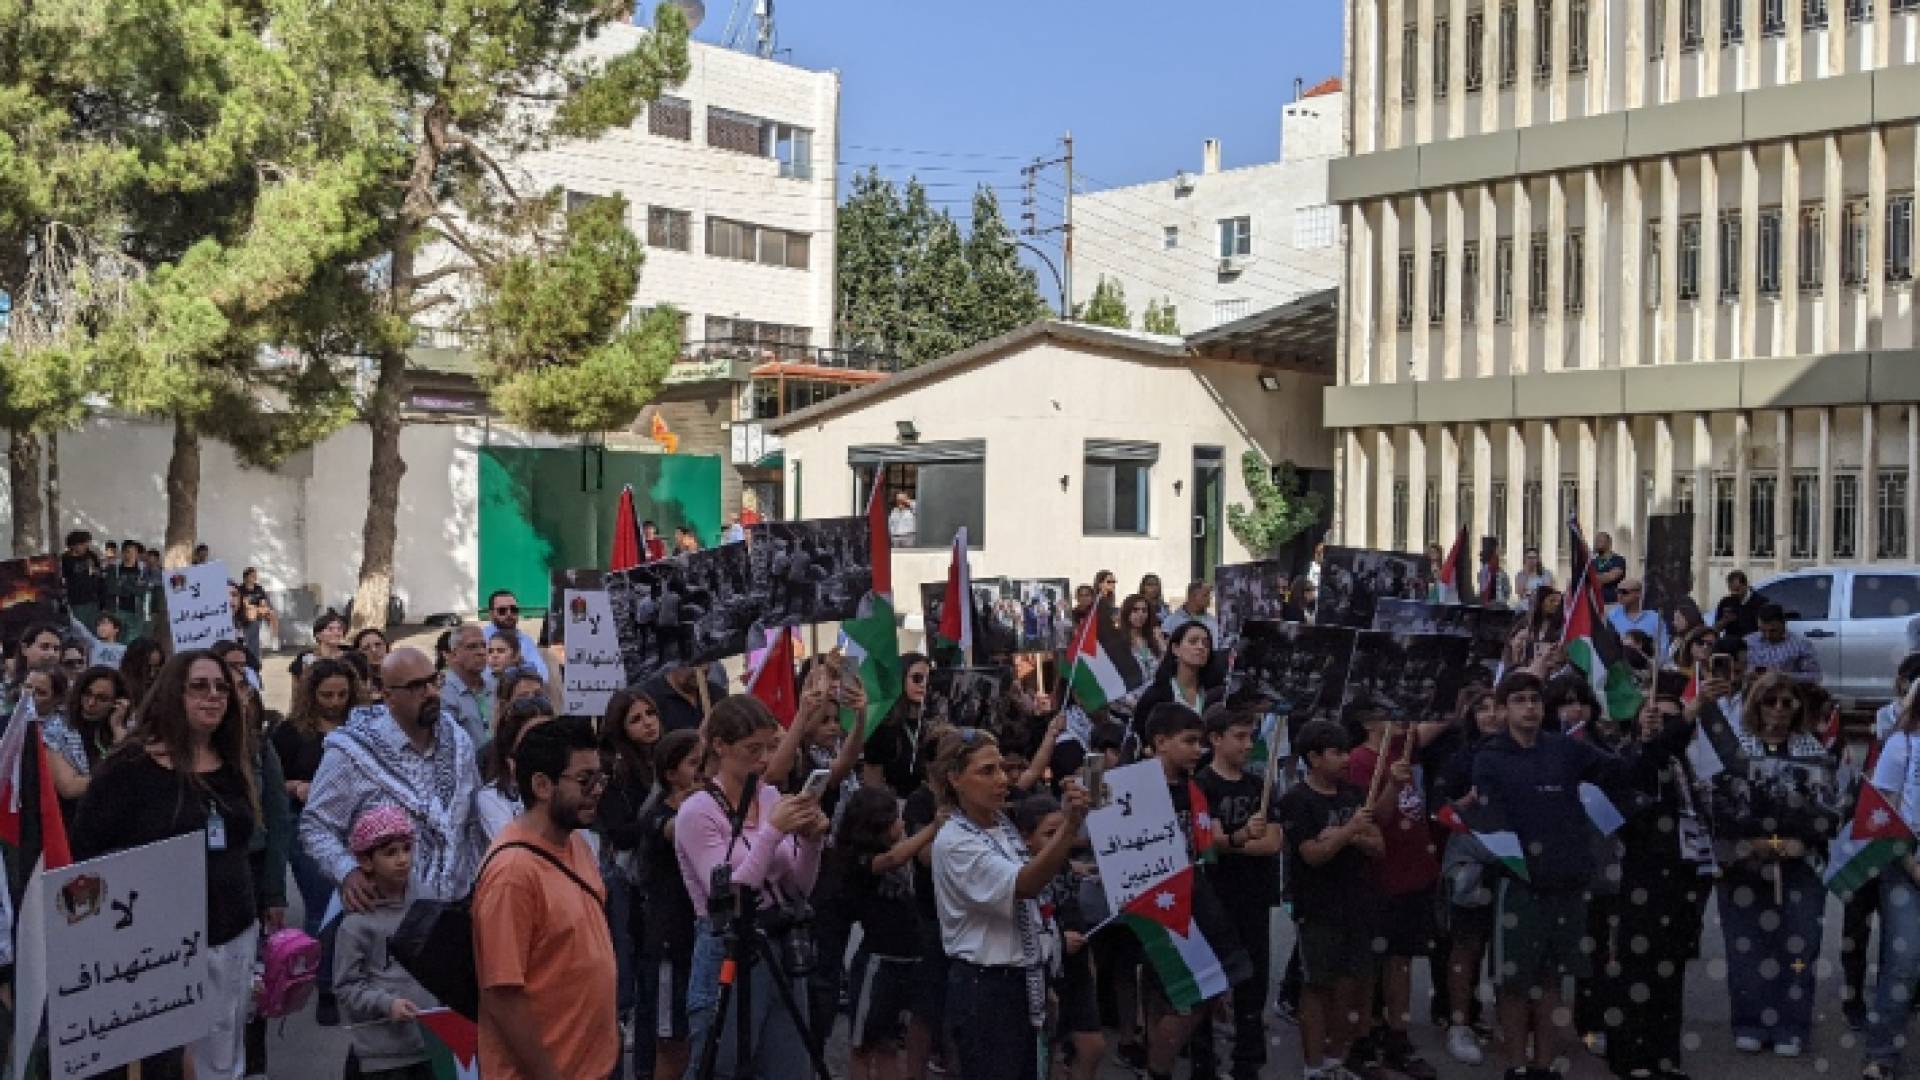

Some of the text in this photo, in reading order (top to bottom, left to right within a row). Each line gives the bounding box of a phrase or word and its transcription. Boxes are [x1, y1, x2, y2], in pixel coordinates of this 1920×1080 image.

[189, 582, 201, 599] لا
[588, 613, 601, 635] لا
[1117, 790, 1132, 816] لا
[111, 890, 138, 930] لا
